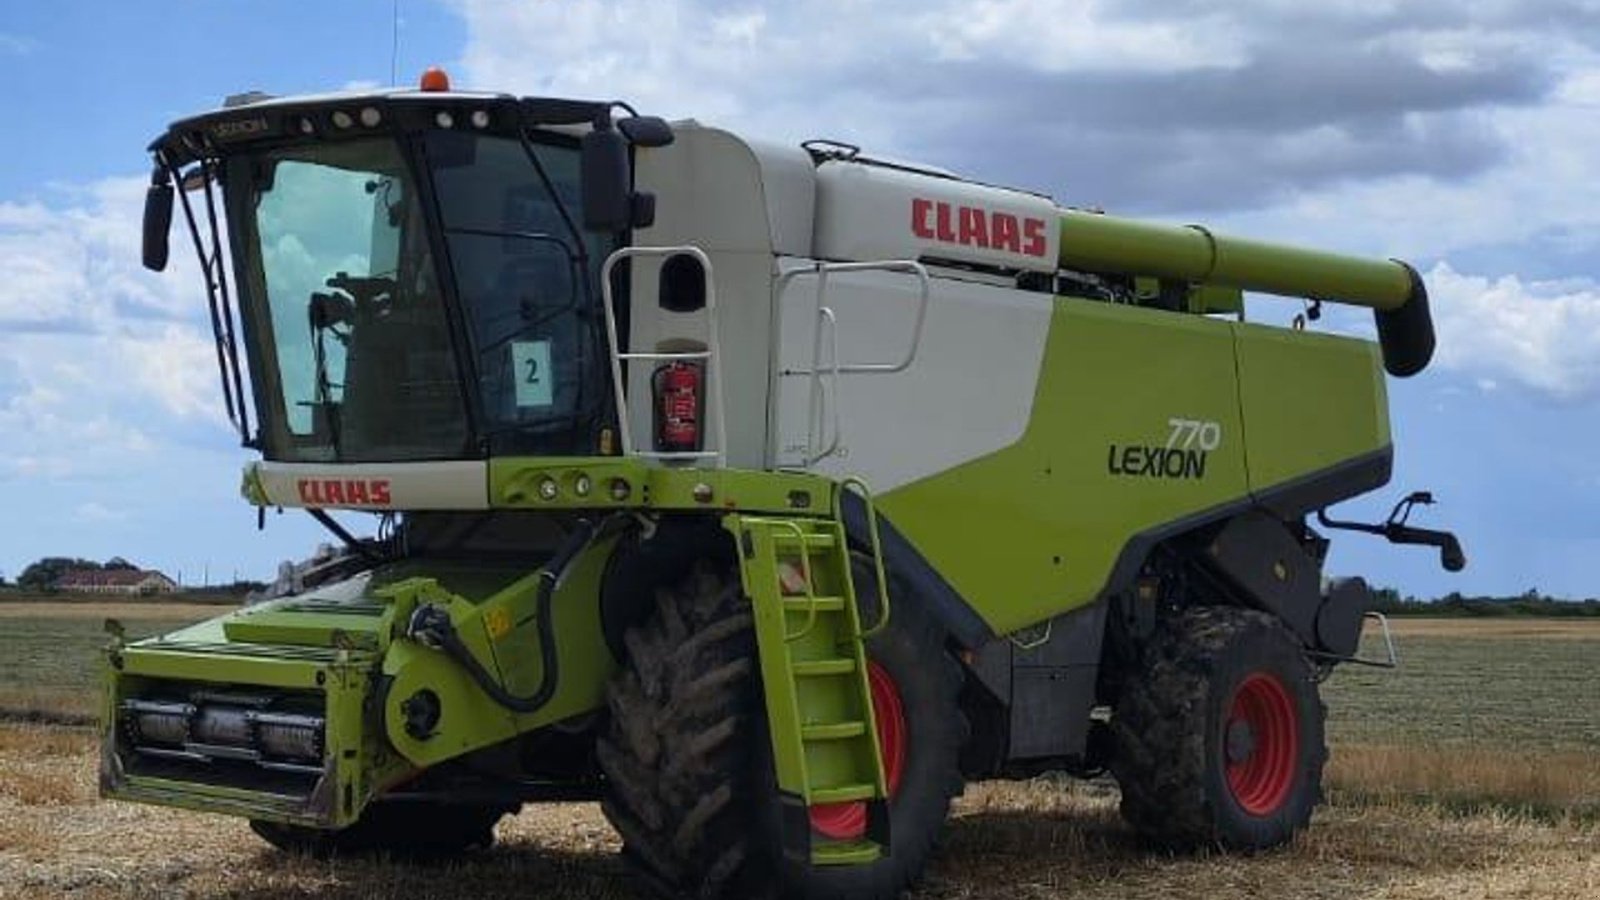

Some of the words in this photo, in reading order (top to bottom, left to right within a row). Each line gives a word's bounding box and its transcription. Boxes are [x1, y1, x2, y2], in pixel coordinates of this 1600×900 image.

[912, 198, 1047, 257] CLAAS
[525, 358, 540, 383] 2
[1167, 419, 1220, 451] 770
[1108, 445, 1206, 479] LEXION
[298, 479, 391, 506] CLAAS
